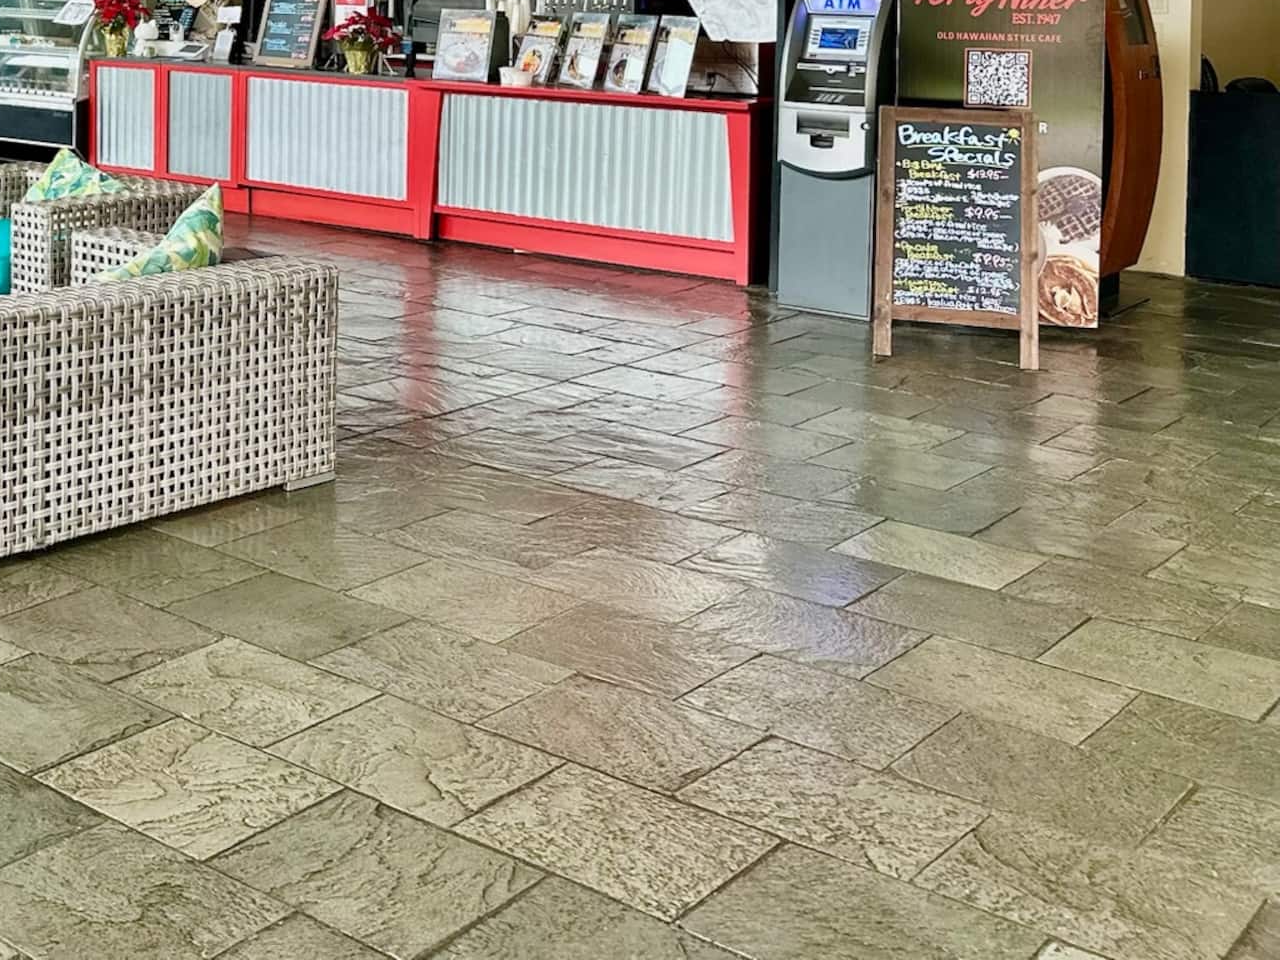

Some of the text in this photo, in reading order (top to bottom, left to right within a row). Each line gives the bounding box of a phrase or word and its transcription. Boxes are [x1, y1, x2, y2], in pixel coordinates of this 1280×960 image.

[1012, 13, 1062, 26] EST. 1947
[936, 31, 955, 40] OLD
[956, 32, 1006, 42] HAWAIIAN
[1007, 33, 1037, 43] STYLE
[898, 124, 1009, 148] Breakfast
